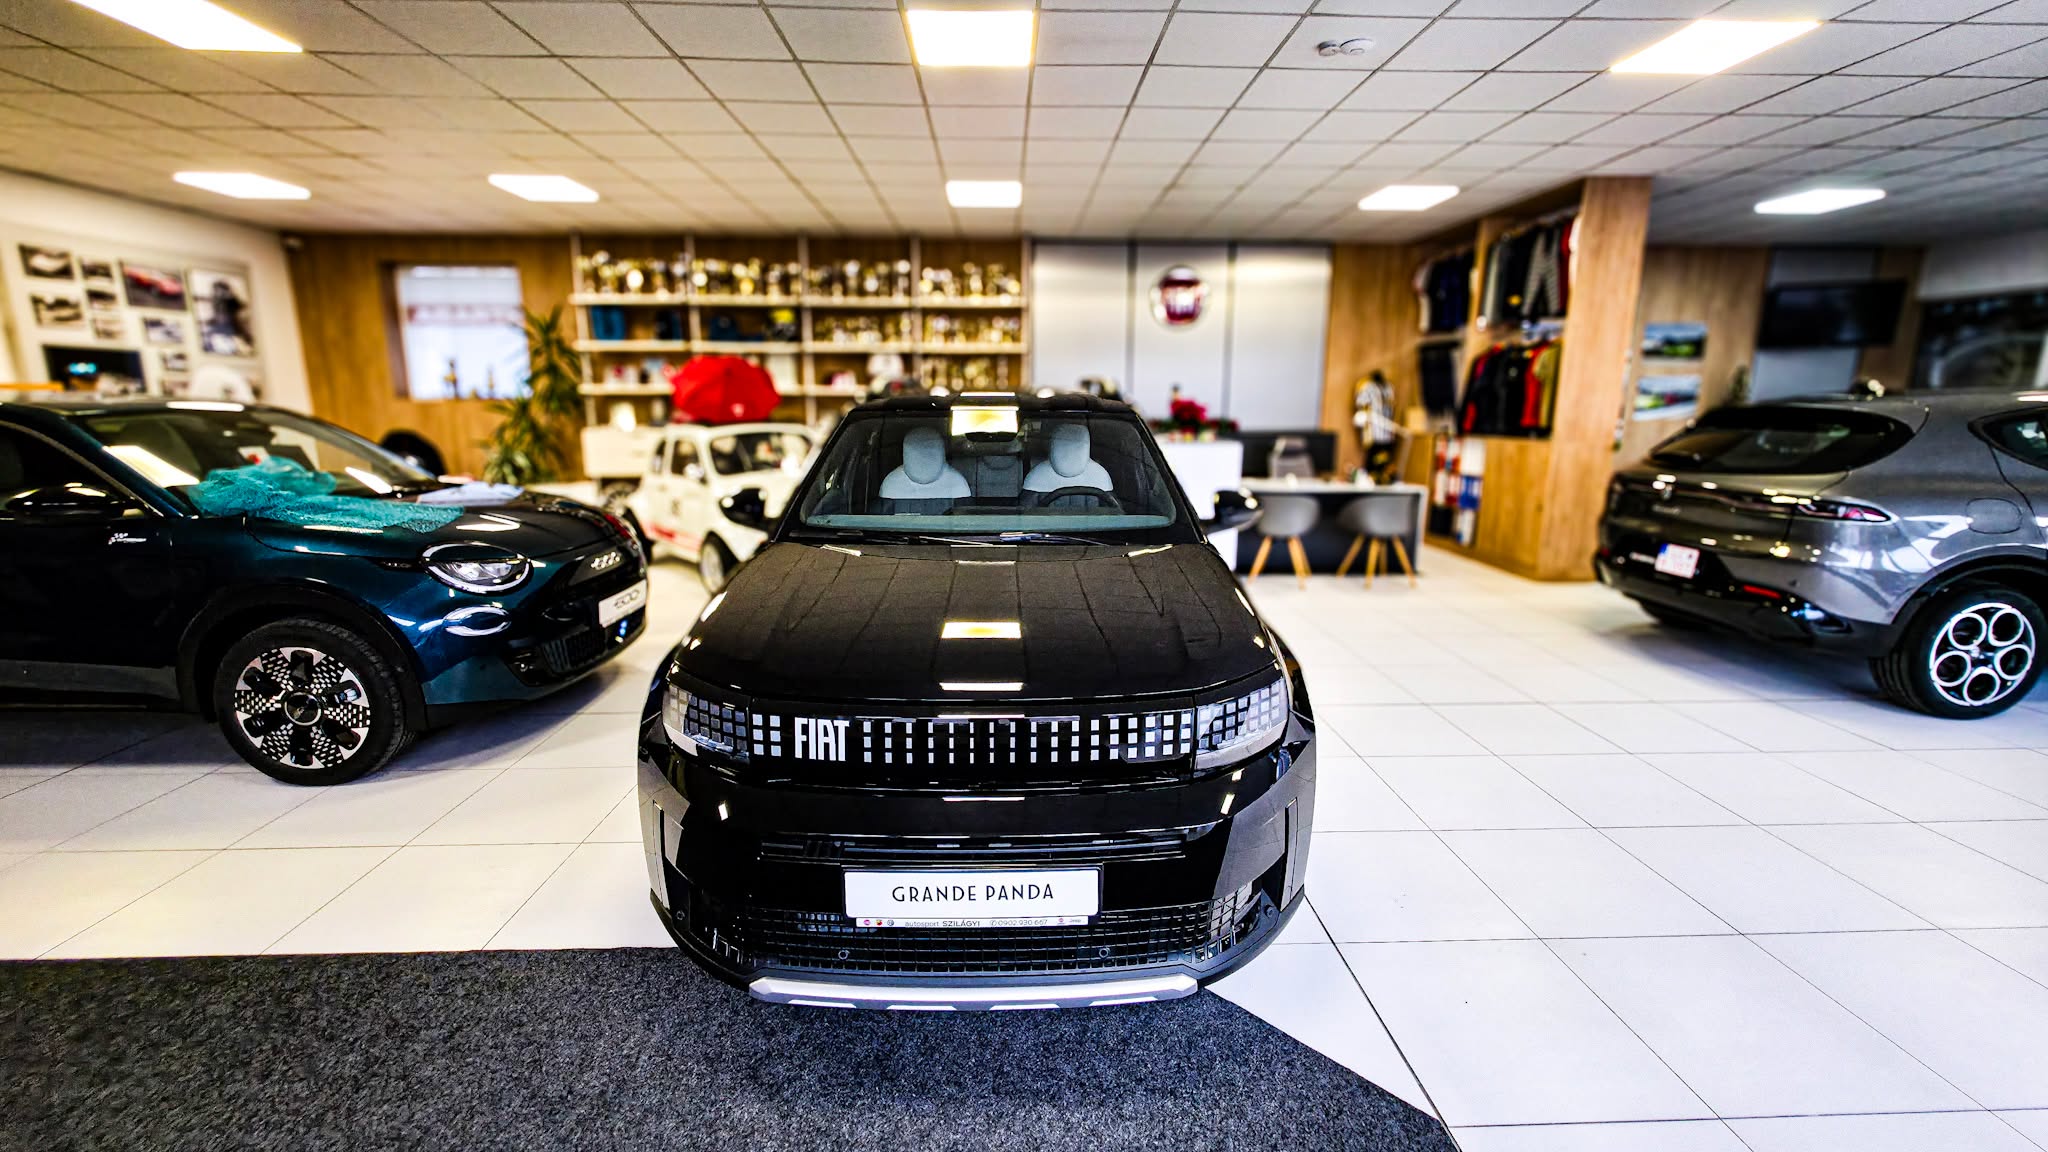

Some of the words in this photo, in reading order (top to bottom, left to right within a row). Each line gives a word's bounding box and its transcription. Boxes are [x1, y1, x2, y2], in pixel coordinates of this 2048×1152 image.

[795, 717, 850, 761] FIAT
[892, 885, 976, 902] GRANDE
[986, 883, 1054, 900] PANDA
[905, 920, 939, 928] autosport
[942, 919, 980, 927] SZILÁGYI
